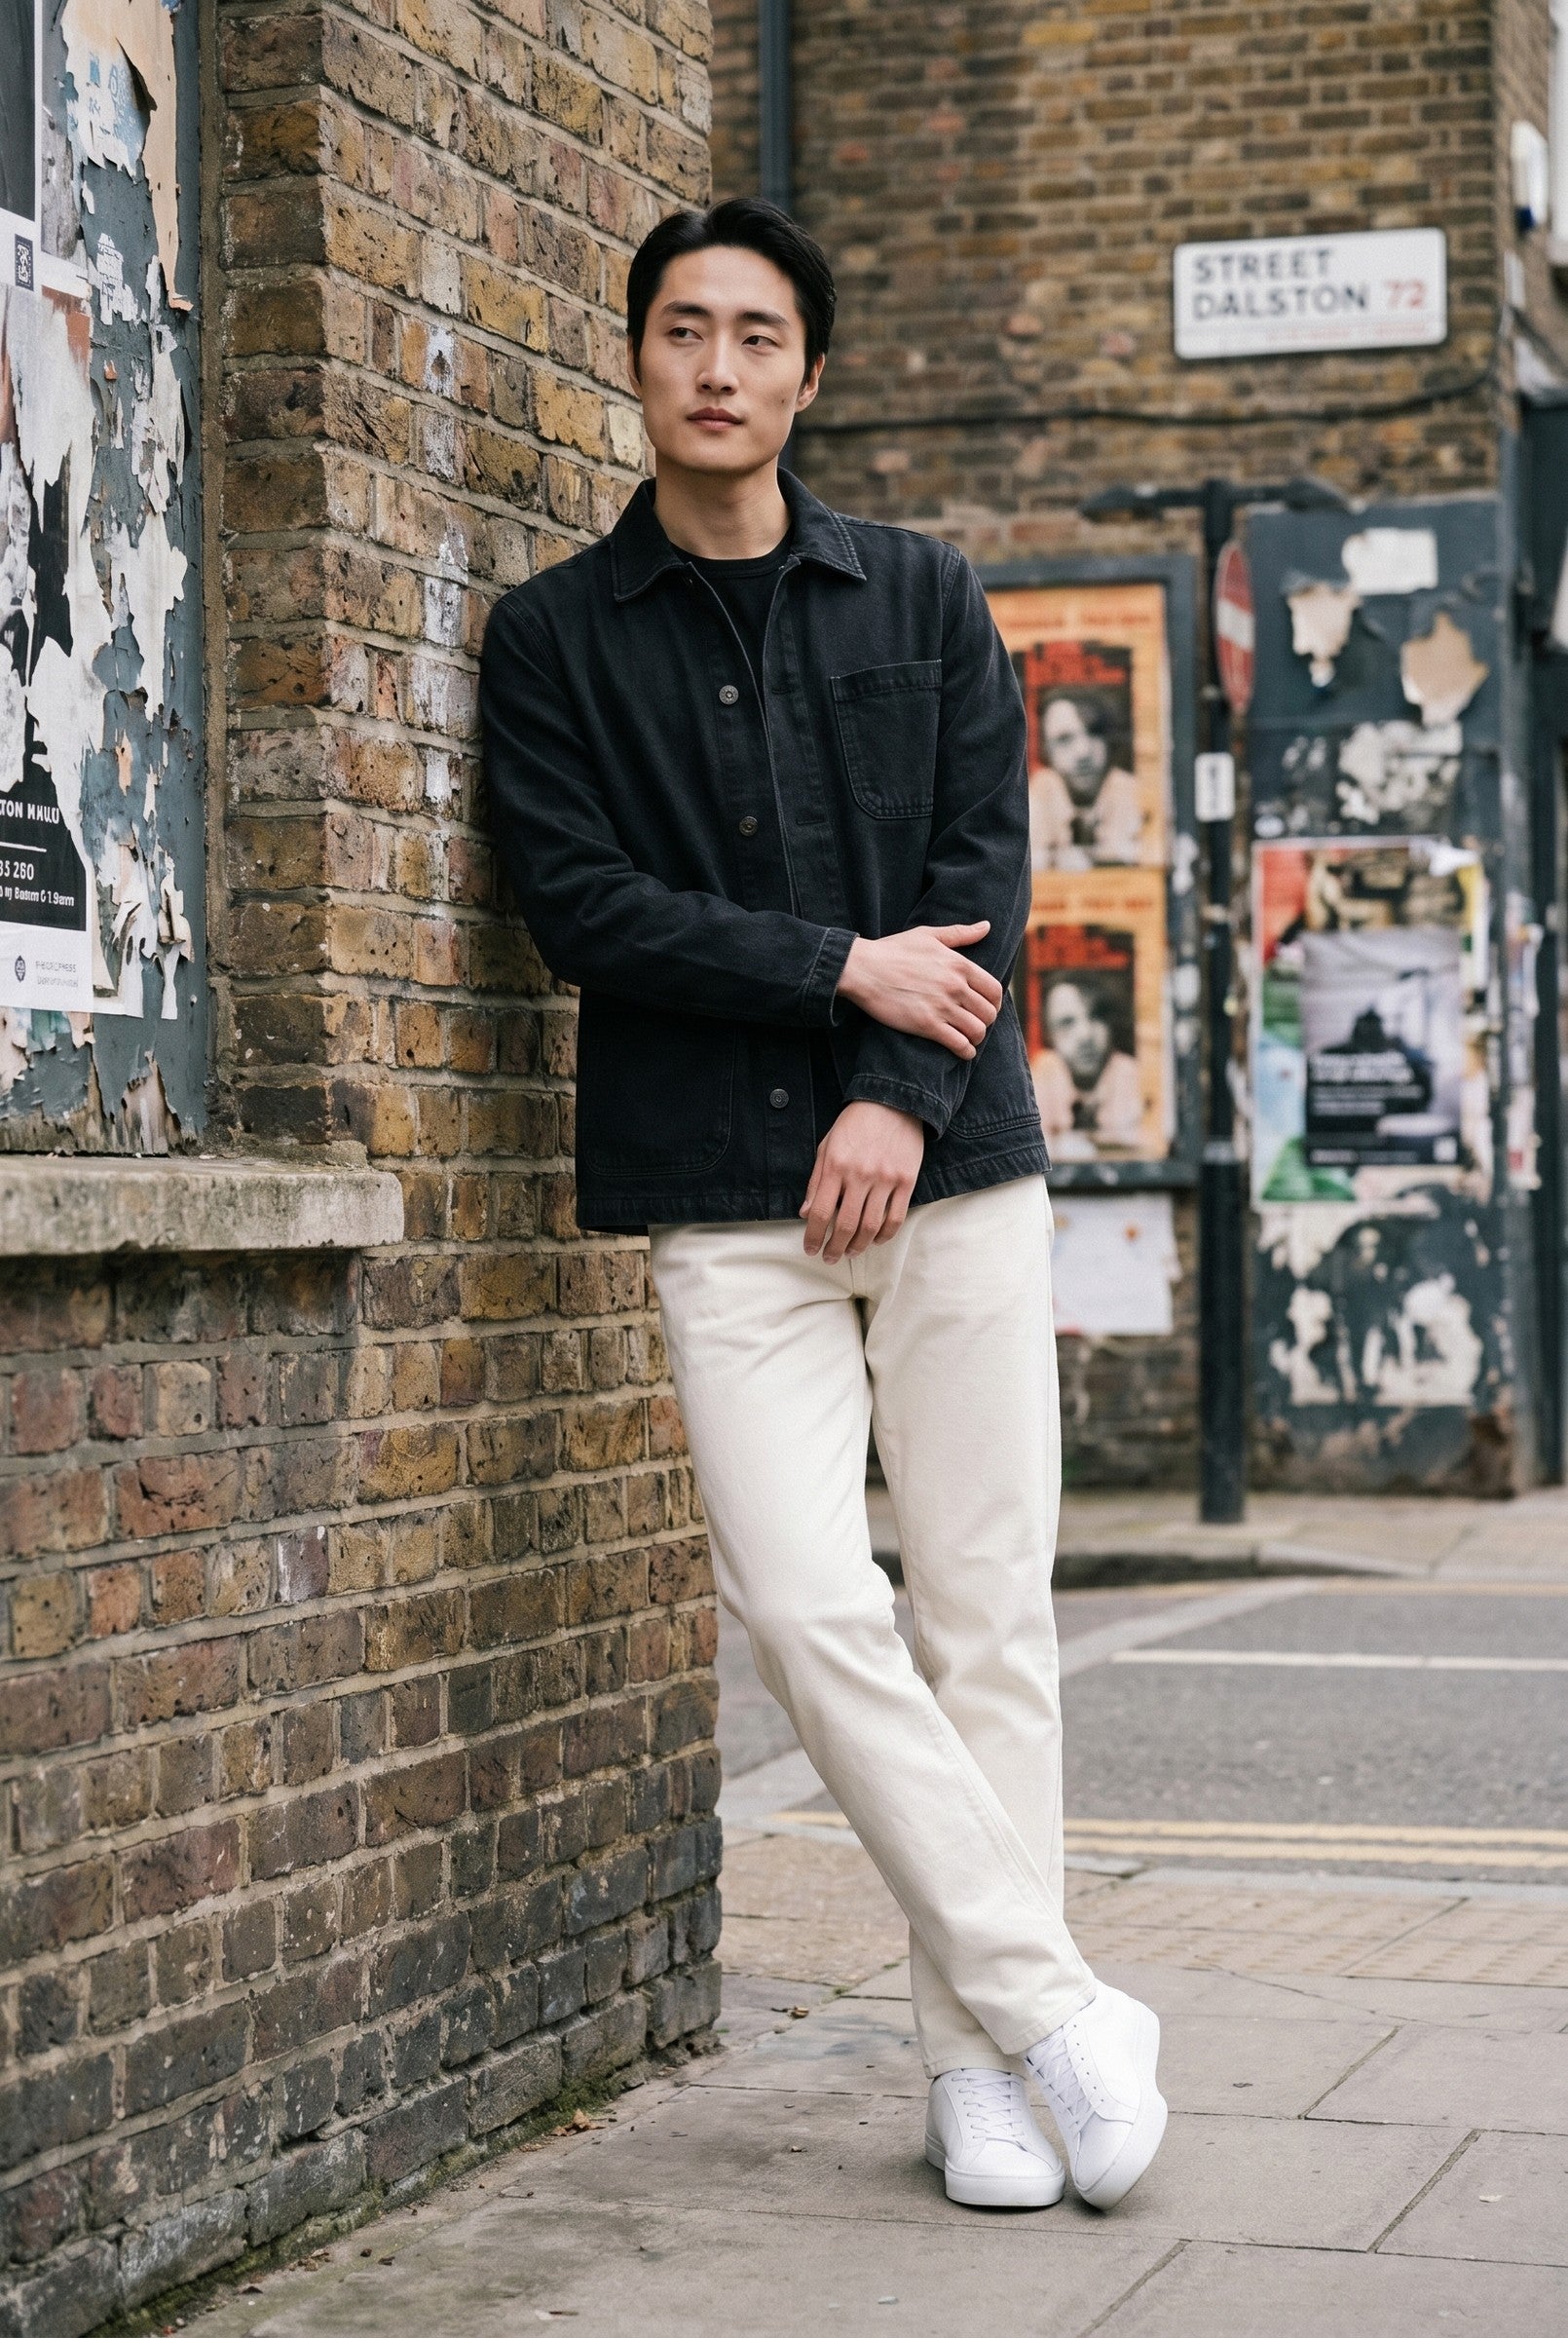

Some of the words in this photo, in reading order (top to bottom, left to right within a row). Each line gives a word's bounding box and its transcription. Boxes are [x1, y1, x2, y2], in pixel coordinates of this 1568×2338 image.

[1194, 248, 1331, 283] STREET
[1193, 283, 1367, 320] DALSTON
[13, 861, 34, 881] 260
